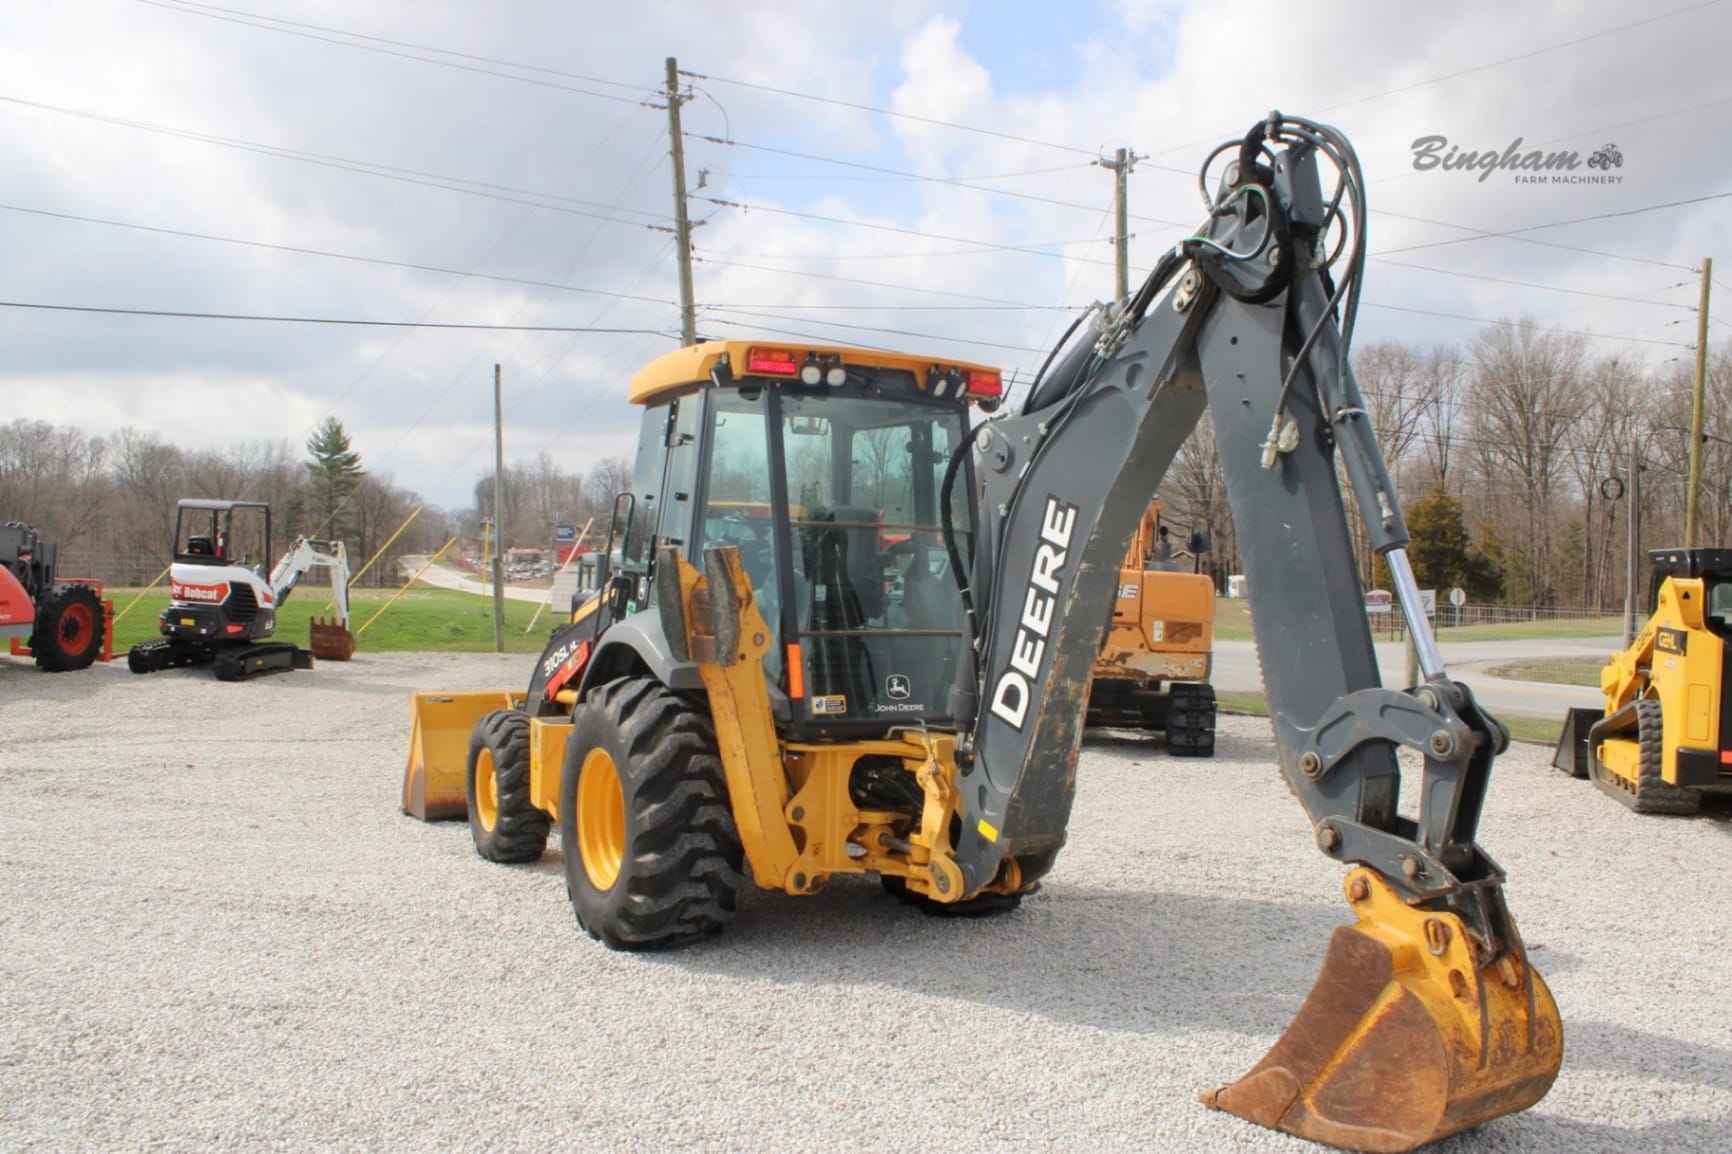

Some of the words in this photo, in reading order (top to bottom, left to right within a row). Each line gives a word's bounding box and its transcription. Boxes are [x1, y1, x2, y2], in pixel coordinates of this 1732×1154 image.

[184, 586, 218, 600] Bobcat
[991, 498, 1077, 729] DEERE
[543, 644, 570, 677] 310SL
[874, 704, 898, 713] JOHN
[898, 704, 925, 712] DEERE
